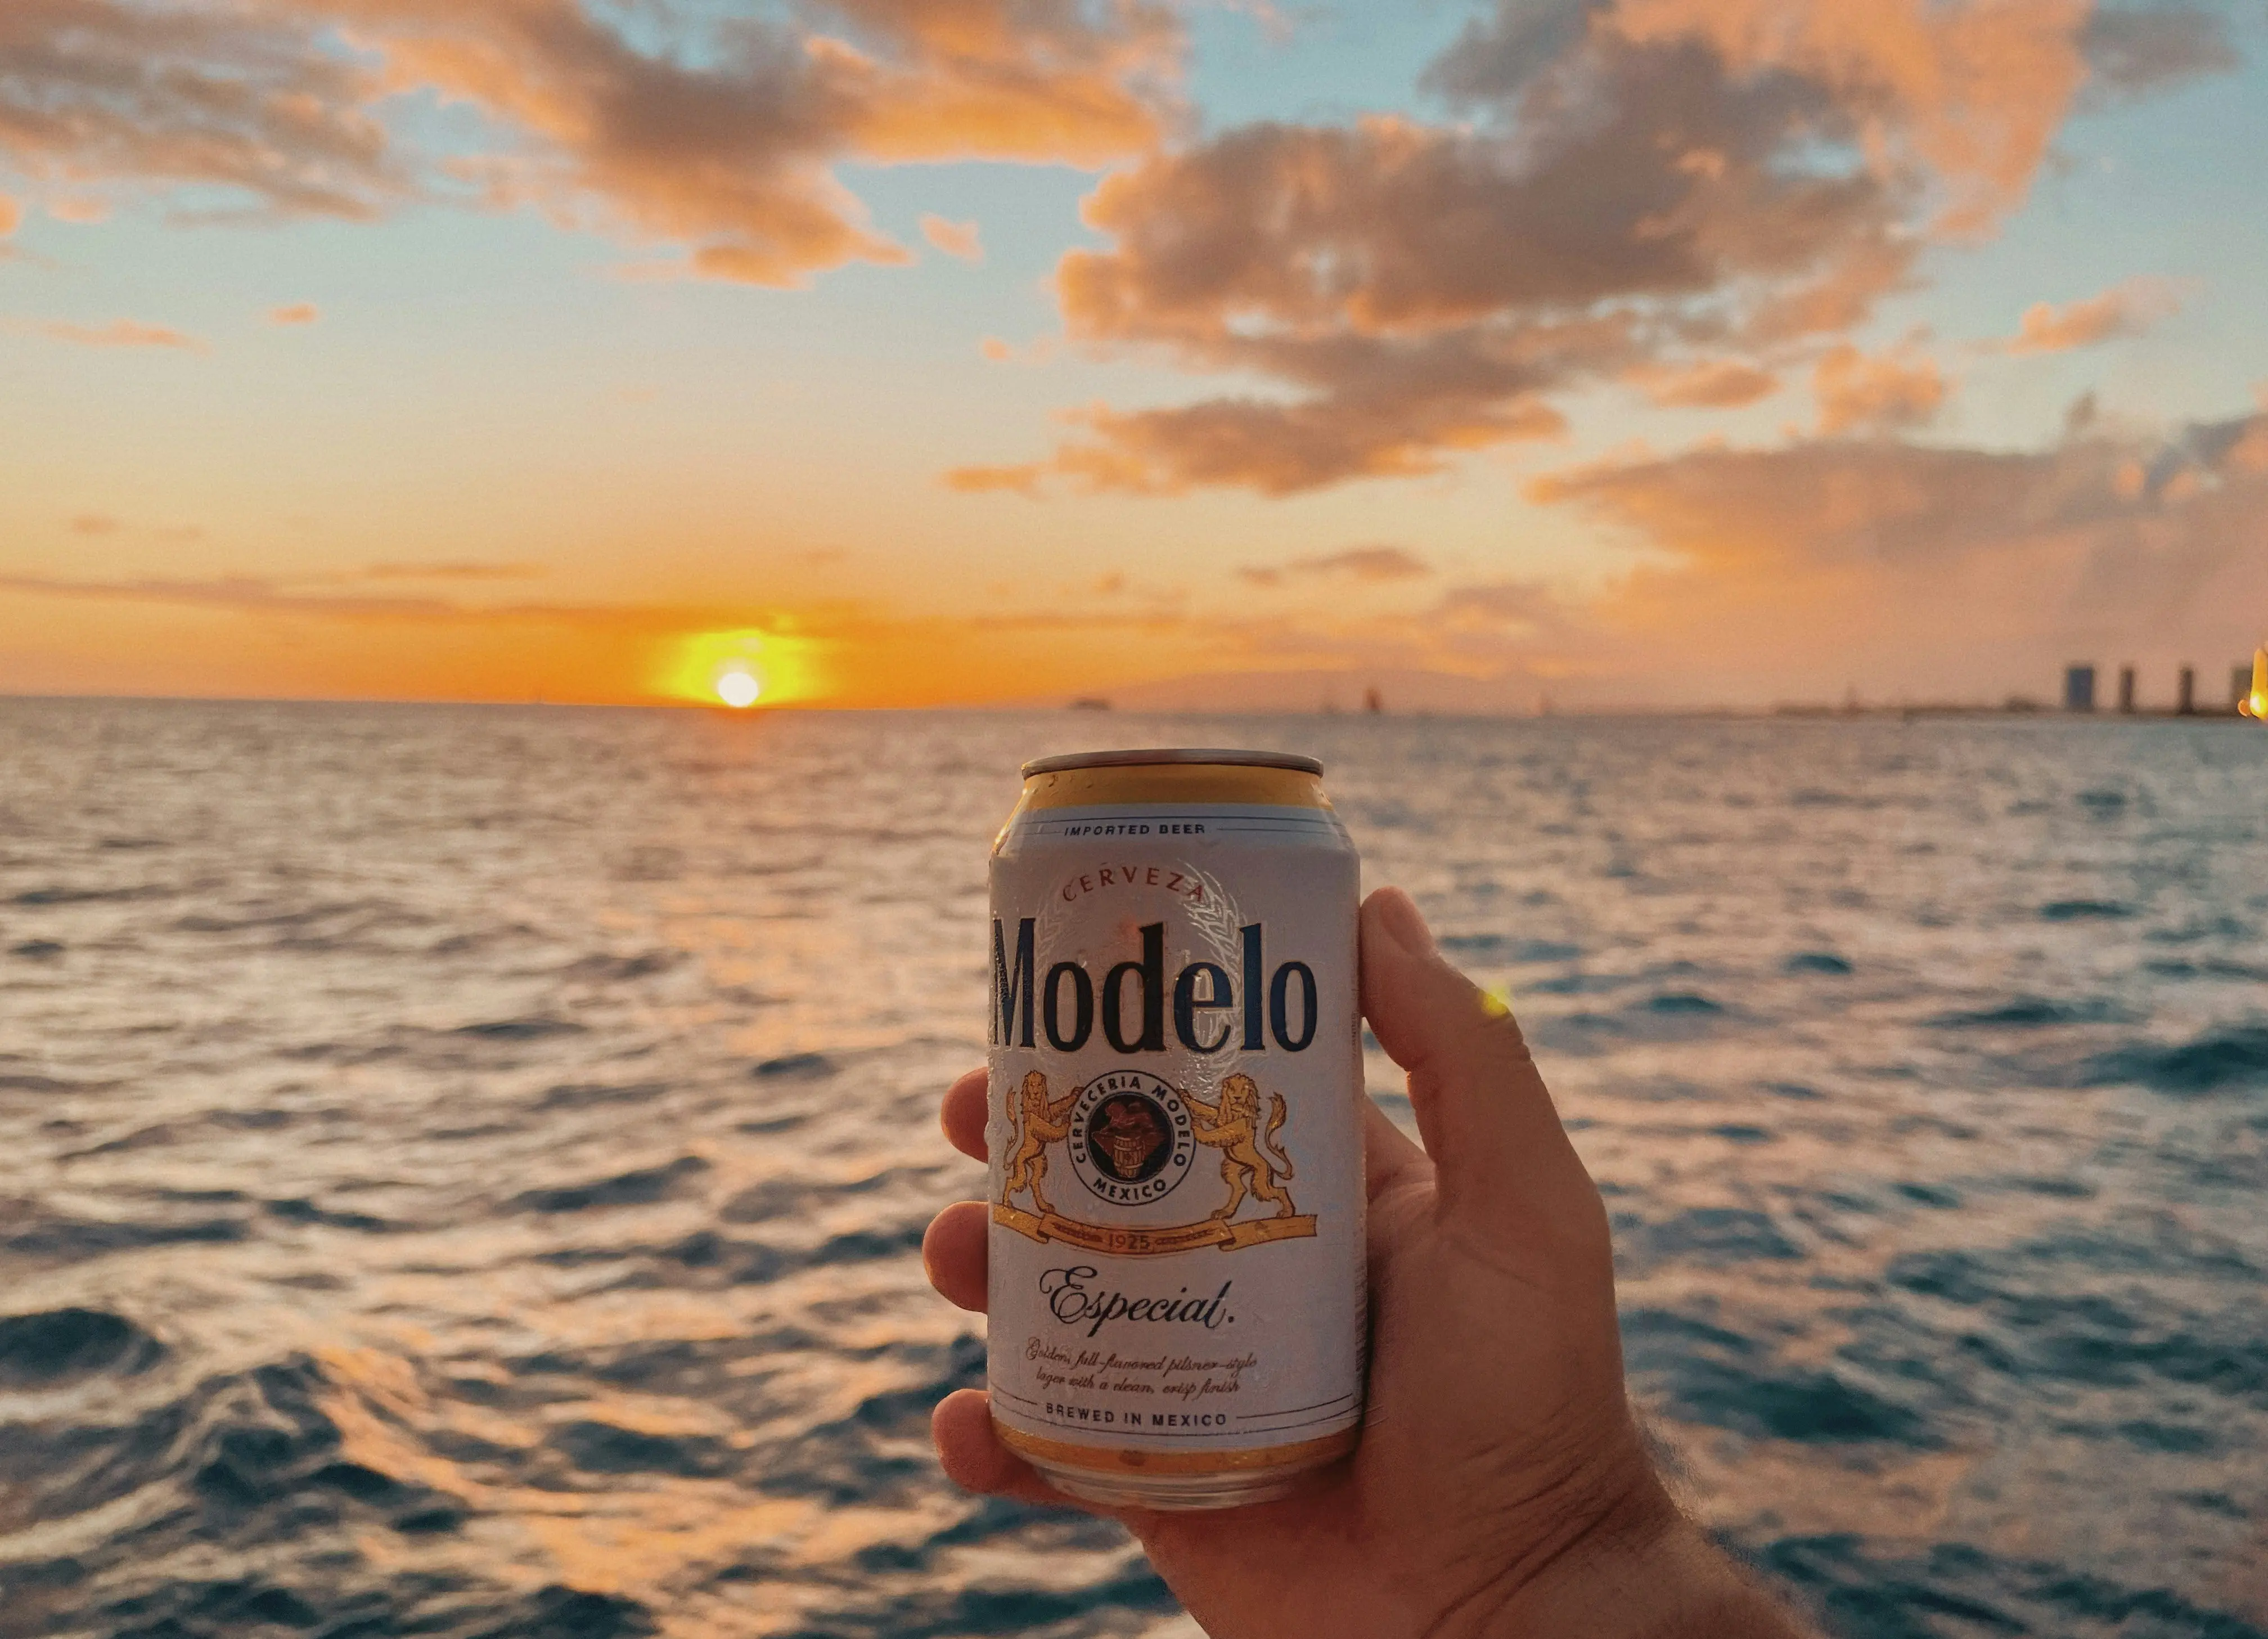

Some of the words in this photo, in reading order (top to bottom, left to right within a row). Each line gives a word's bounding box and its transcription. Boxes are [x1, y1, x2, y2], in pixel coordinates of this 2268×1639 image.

[1064, 824, 1150, 837] IMPORTED
[1158, 823, 1205, 835] BEER
[1063, 865, 1205, 902] CERVEZA
[993, 918, 1317, 1054] Modelo
[1073, 1076, 1141, 1164] CERVECERIA
[1151, 1085, 1190, 1166] MODELO
[1093, 1177, 1167, 1201] MEXICO
[1108, 1233, 1151, 1250] 1925
[1039, 1265, 1236, 1338] Especial.
[1036, 1366, 1066, 1390] lager
[1068, 1373, 1095, 1389] with
[1099, 1380, 1110, 1390] a
[1162, 1381, 1197, 1402] crisp
[1191, 1377, 1241, 1401] finish
[1045, 1403, 1115, 1425] BREWED
[1124, 1413, 1142, 1426] IN
[1152, 1413, 1227, 1427] MEXICO
